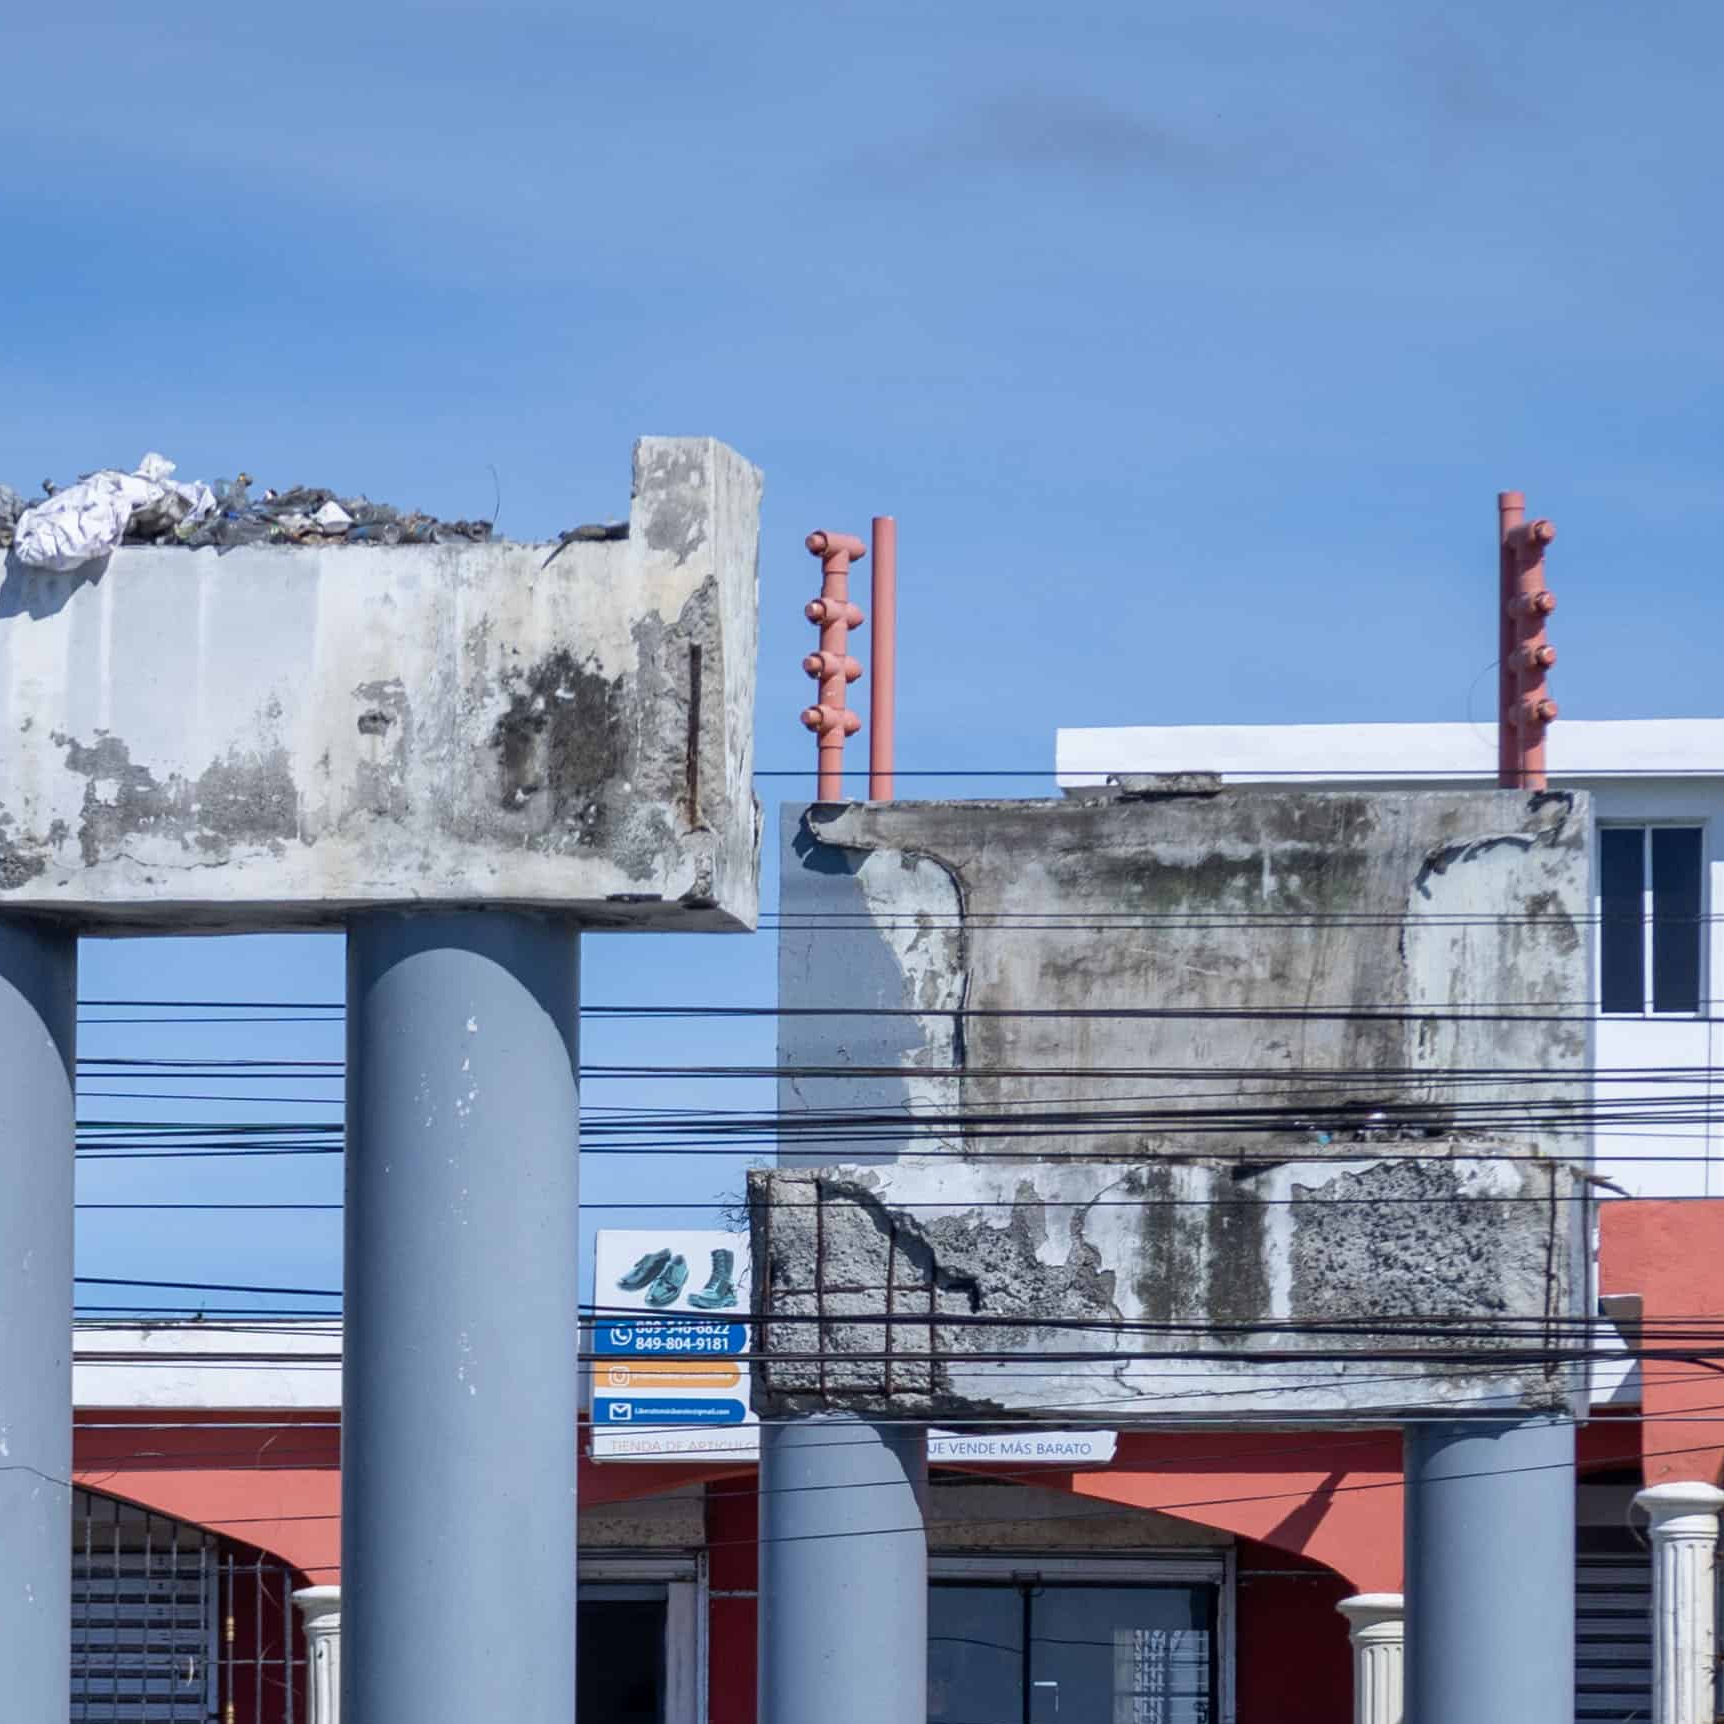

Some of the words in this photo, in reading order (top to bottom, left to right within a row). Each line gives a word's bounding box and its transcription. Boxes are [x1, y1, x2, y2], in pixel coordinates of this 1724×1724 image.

[635, 1337, 729, 1350] 849-804-9181
[928, 1443, 947, 1455] UE
[949, 1443, 996, 1455] VENDE
[1001, 1441, 1032, 1455] MÁS
[1036, 1443, 1092, 1455] BARATO
